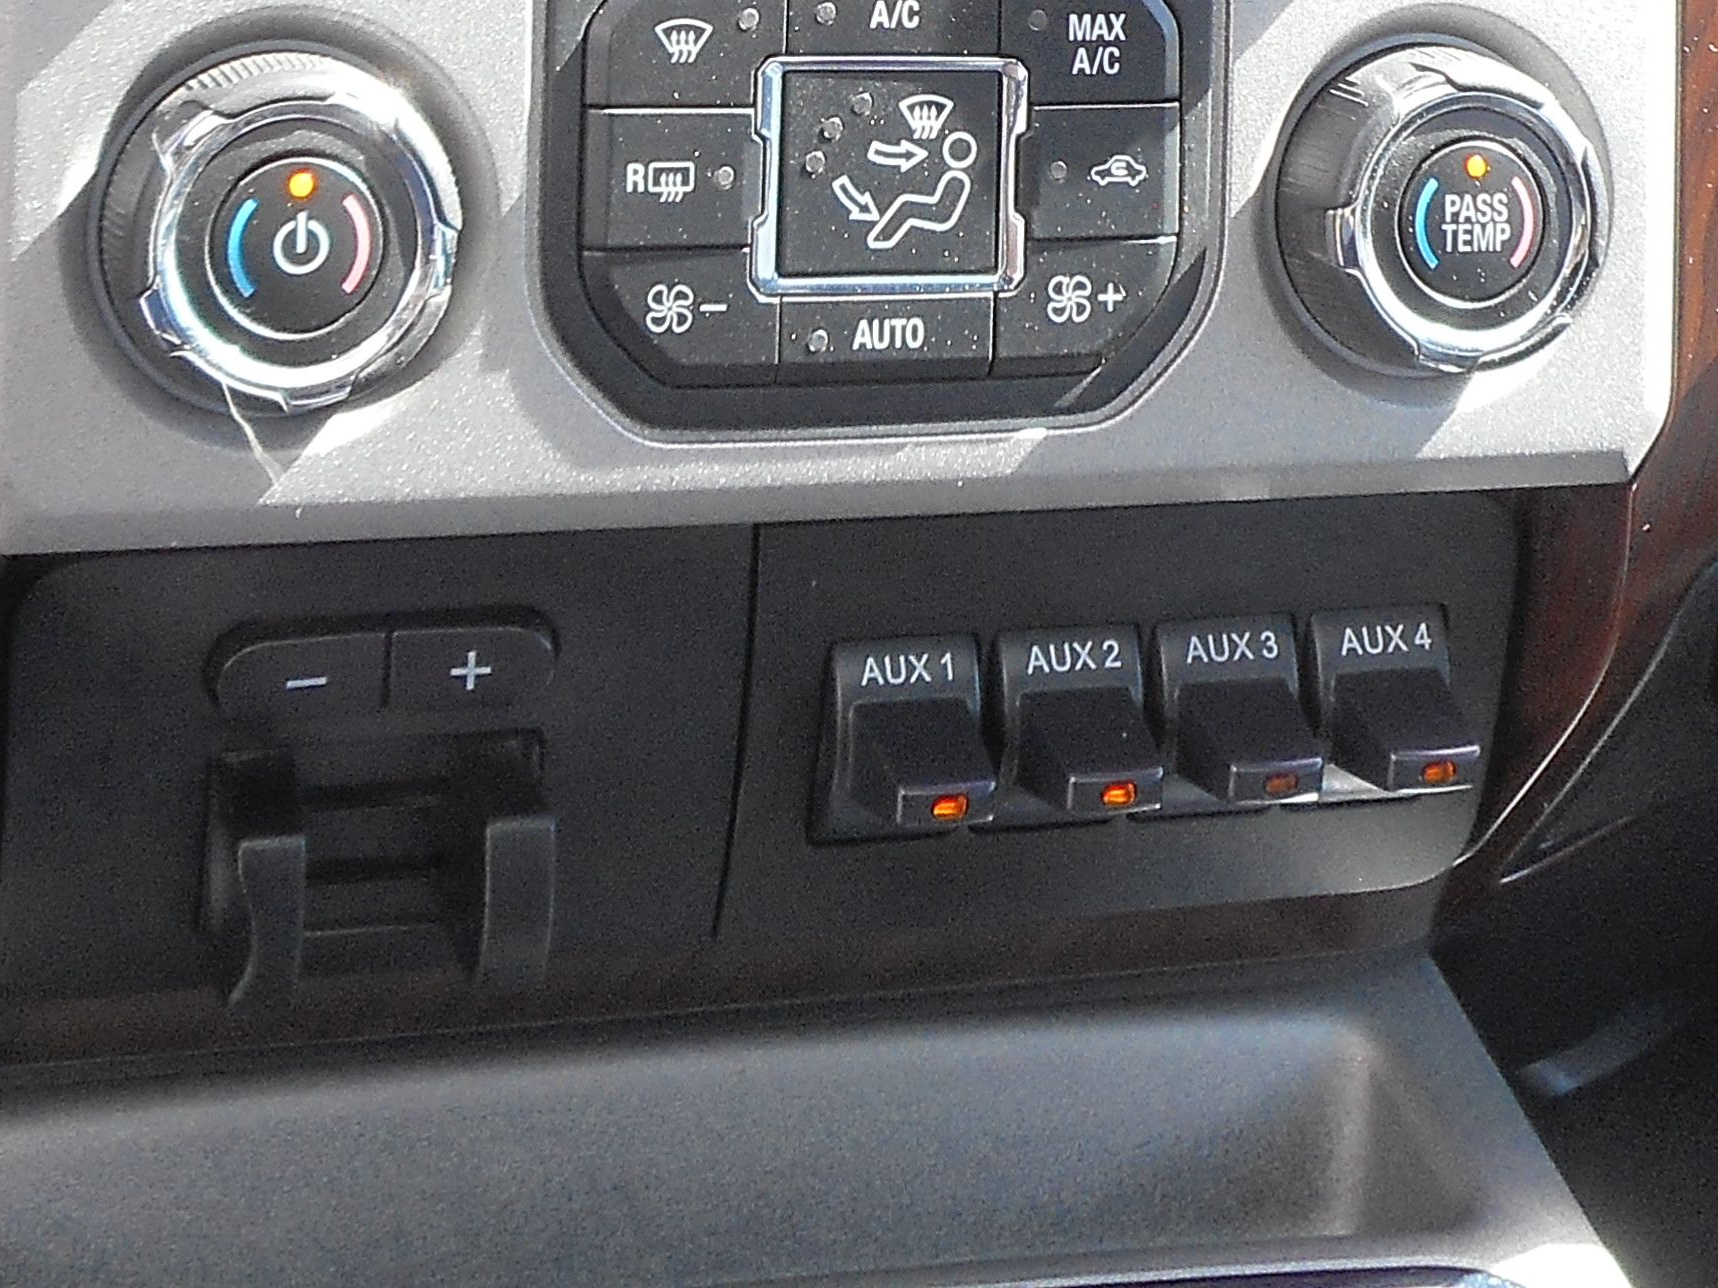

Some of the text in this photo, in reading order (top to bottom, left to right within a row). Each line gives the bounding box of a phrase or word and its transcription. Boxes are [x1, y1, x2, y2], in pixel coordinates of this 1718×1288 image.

[869, 0, 920, 29] A/C
[1068, 13, 1126, 42] MAX
[1071, 49, 1120, 75] A/C
[626, 162, 646, 193] R
[1444, 192, 1510, 224] PASS
[1441, 222, 1512, 254] TEMP
[852, 316, 928, 352] AUTO
[1186, 630, 1279, 664] AUX 3
[1341, 622, 1432, 656] AUX 4
[861, 652, 954, 686] AUX 1
[1027, 639, 1122, 675] AUX 2
